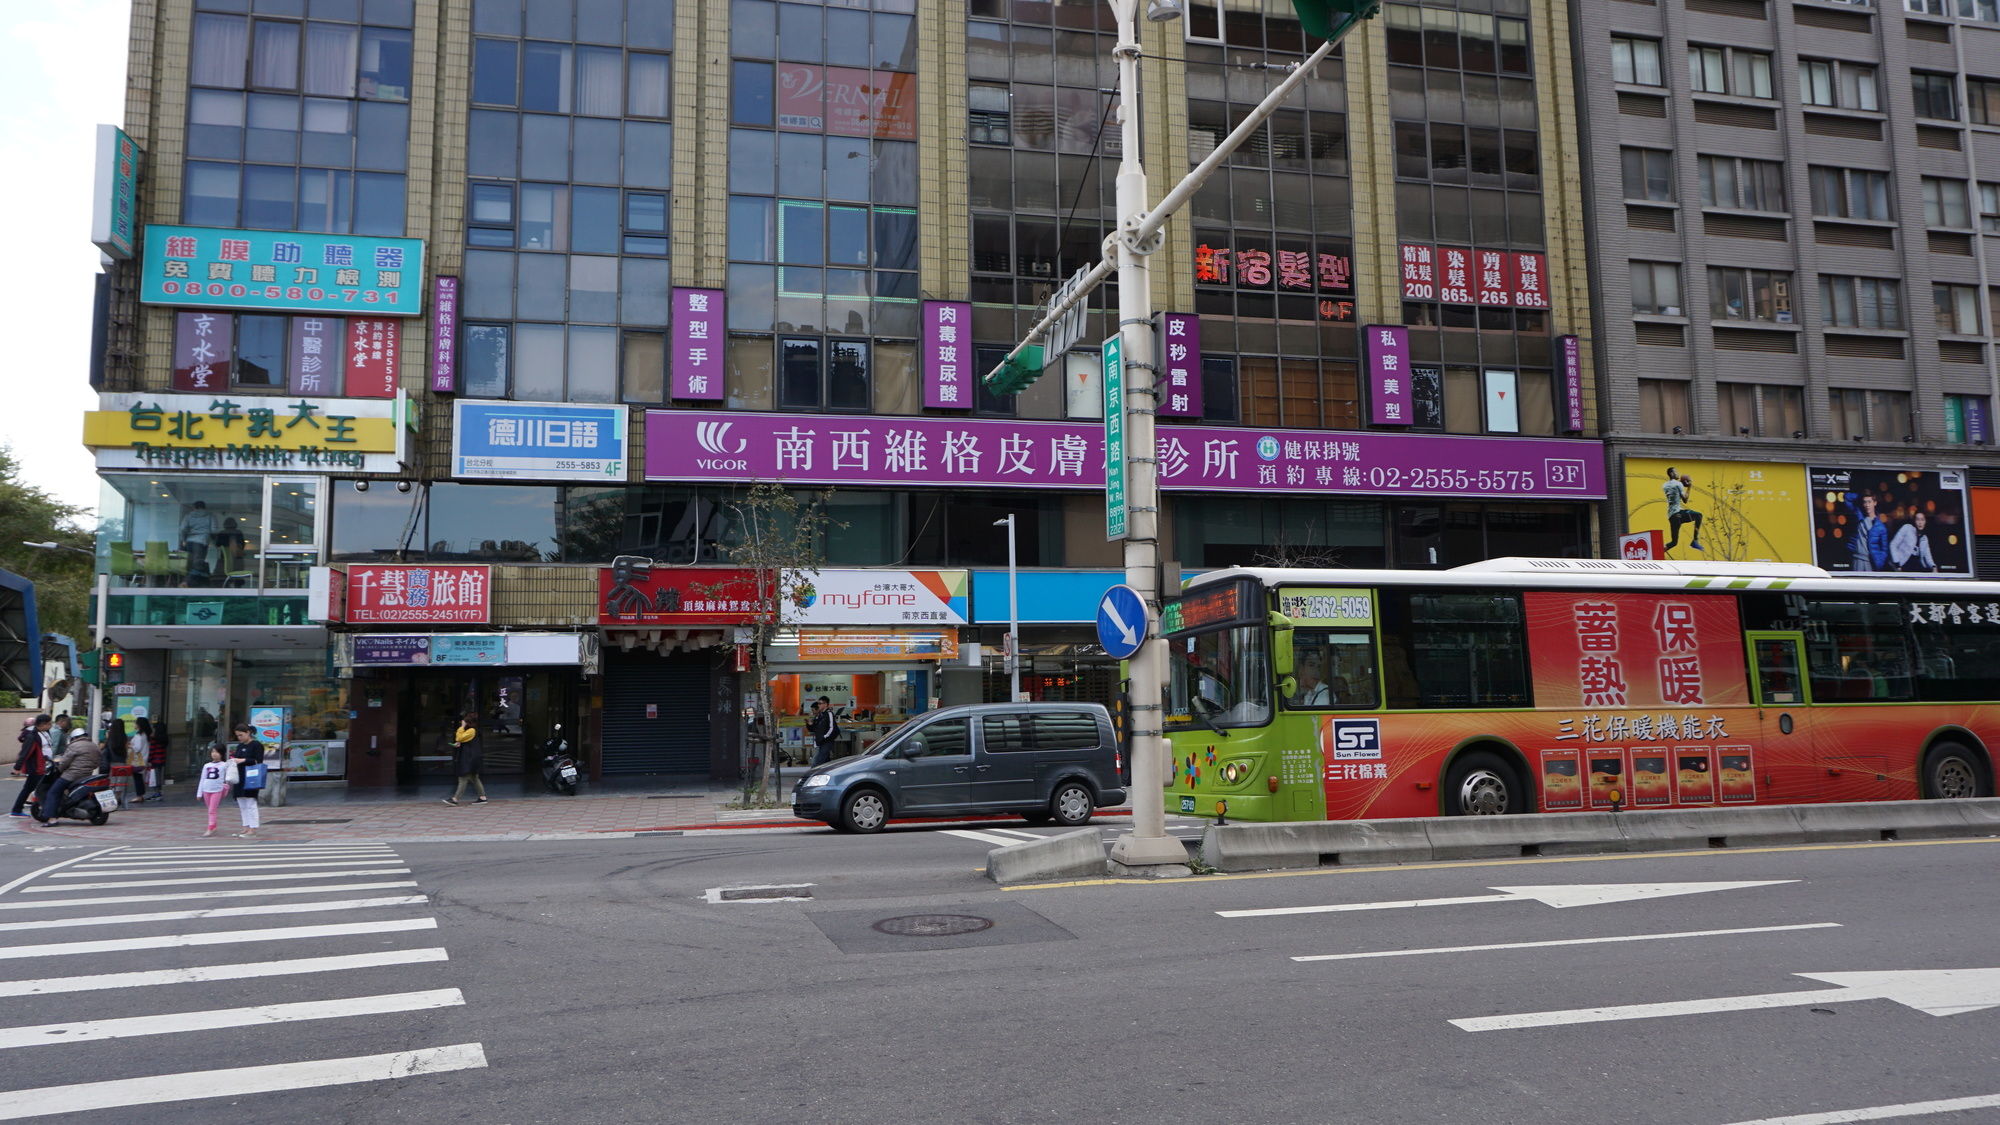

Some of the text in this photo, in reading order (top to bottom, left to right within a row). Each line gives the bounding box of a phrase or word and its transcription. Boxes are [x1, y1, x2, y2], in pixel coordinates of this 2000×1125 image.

[165, 237, 403, 269] 維膜助聽器
[1195, 244, 1349, 289] 新宿髮型
[163, 261, 400, 288] 免費聽力檢測
[1447, 251, 1465, 287] 染髮
[1483, 252, 1502, 288] 剪髮
[162, 282, 399, 303] 0800-580-731
[1406, 283, 1432, 298] 200
[1481, 291, 1508, 304] 265
[1319, 300, 1353, 320] 4F
[190, 314, 216, 388] 京水堂
[300, 319, 323, 392] 中醫診所
[353, 320, 369, 368] 京水堂
[384, 323, 394, 391] 25585592
[437, 301, 452, 387] 維格皮膚科診所
[689, 294, 708, 393] 整型手術
[939, 306, 958, 402] 肉毒玻尿酸
[1169, 318, 1189, 412] 皮秒雷射
[1381, 330, 1401, 419] 私密美型
[129, 399, 357, 443] 台北牛乳大王
[1108, 360, 1120, 463] 南京西路
[488, 419, 598, 448] 德川日語
[131, 441, 362, 466] Taipei Milk King
[1284, 440, 1361, 461] 健保掛號
[556, 460, 600, 469] 2555-5853
[605, 461, 621, 476] 4F
[696, 458, 747, 471] VIGOR
[1551, 465, 1580, 484] 3F
[823, 590, 916, 608] myfone
[874, 584, 915, 592] 台灣大哥大
[902, 611, 948, 620] 南京西直營
[1308, 595, 1370, 619] 2562-5059
[1909, 602, 2000, 625] 大都會客運
[1573, 602, 1627, 707] 蓄熱
[1653, 603, 1704, 706] 保暖
[1337, 726, 1375, 748] SF
[1555, 714, 1730, 742] 三花保暖機能衣
[206, 767, 219, 779] B
[1328, 763, 1388, 780] 三花棉業
